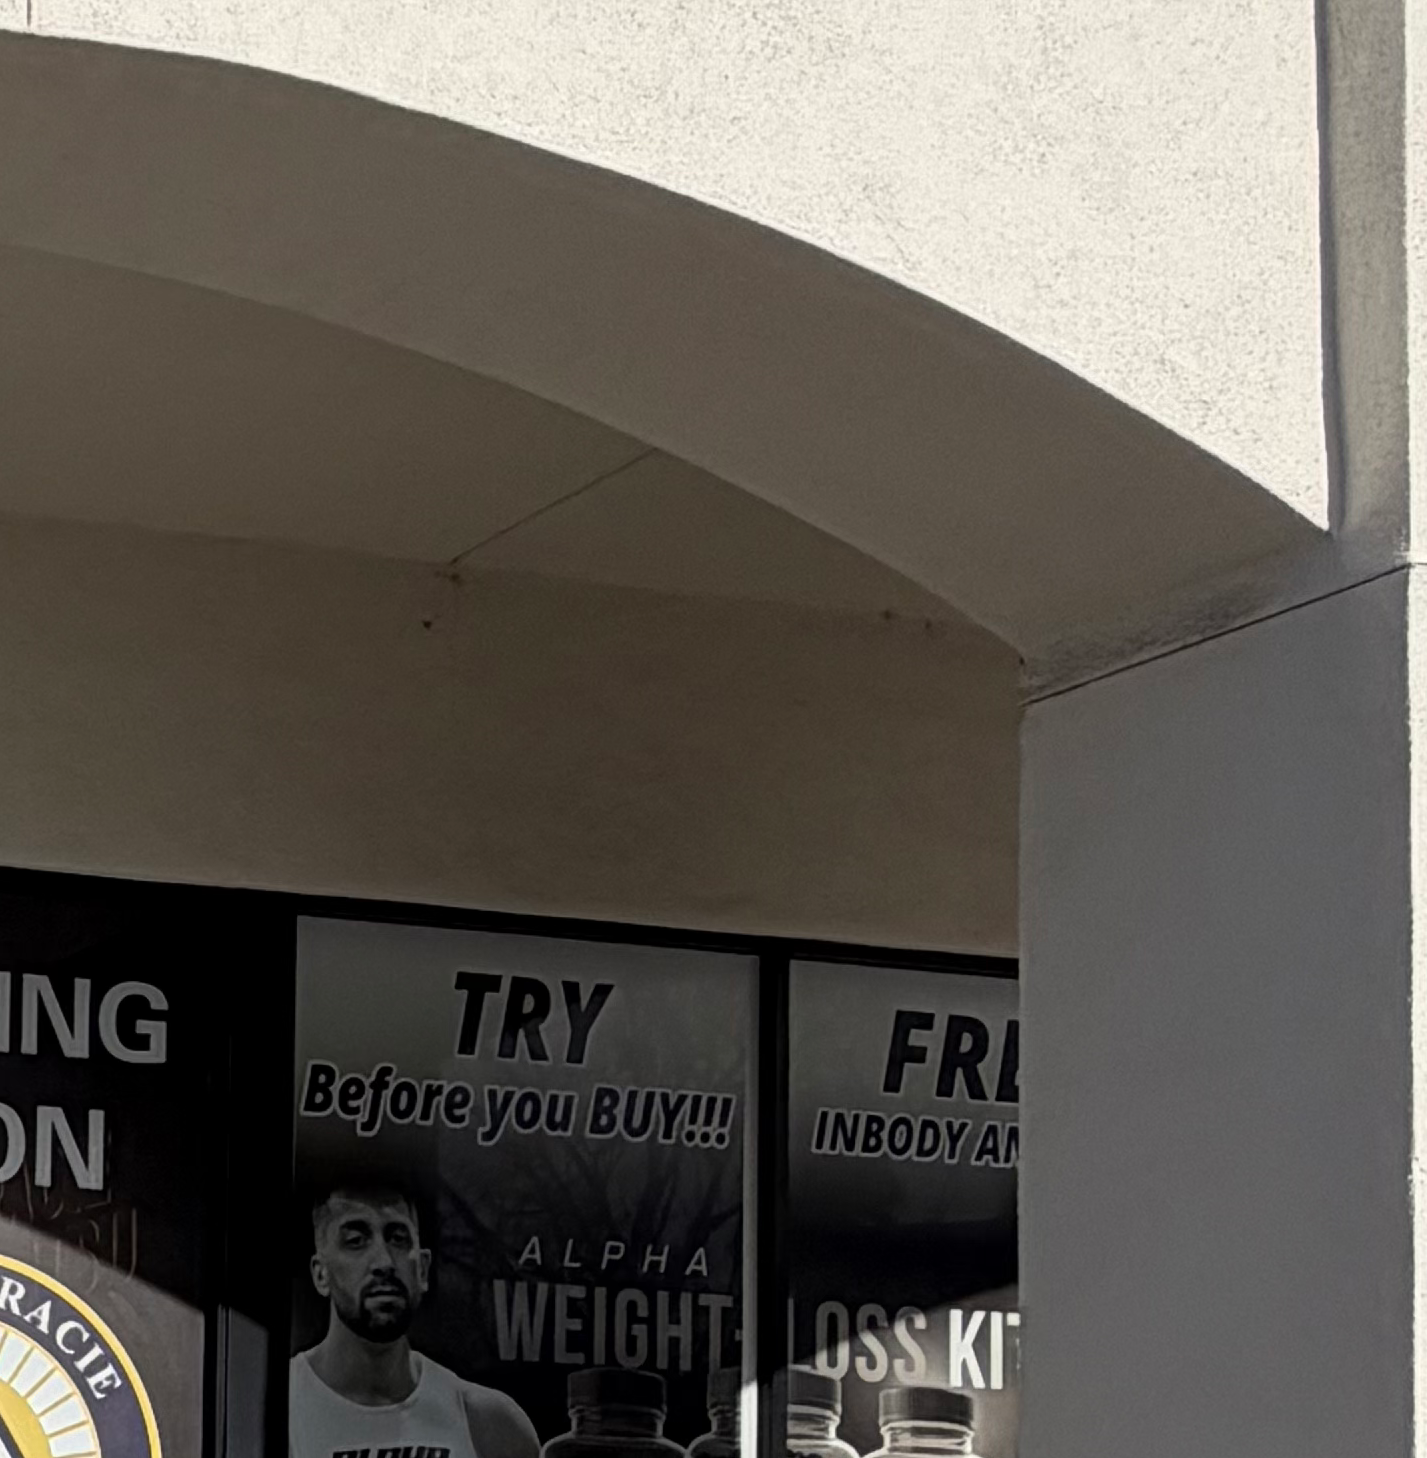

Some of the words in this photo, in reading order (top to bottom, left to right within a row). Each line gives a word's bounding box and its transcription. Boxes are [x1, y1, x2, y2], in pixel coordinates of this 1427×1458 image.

[453, 970, 615, 1065] TRY
[302, 1062, 473, 1134] Before
[480, 1086, 576, 1144] you
[588, 1085, 734, 1148] BUY!!!
[814, 1109, 970, 1160] INBODY
[518, 1236, 708, 1277] ALPHA
